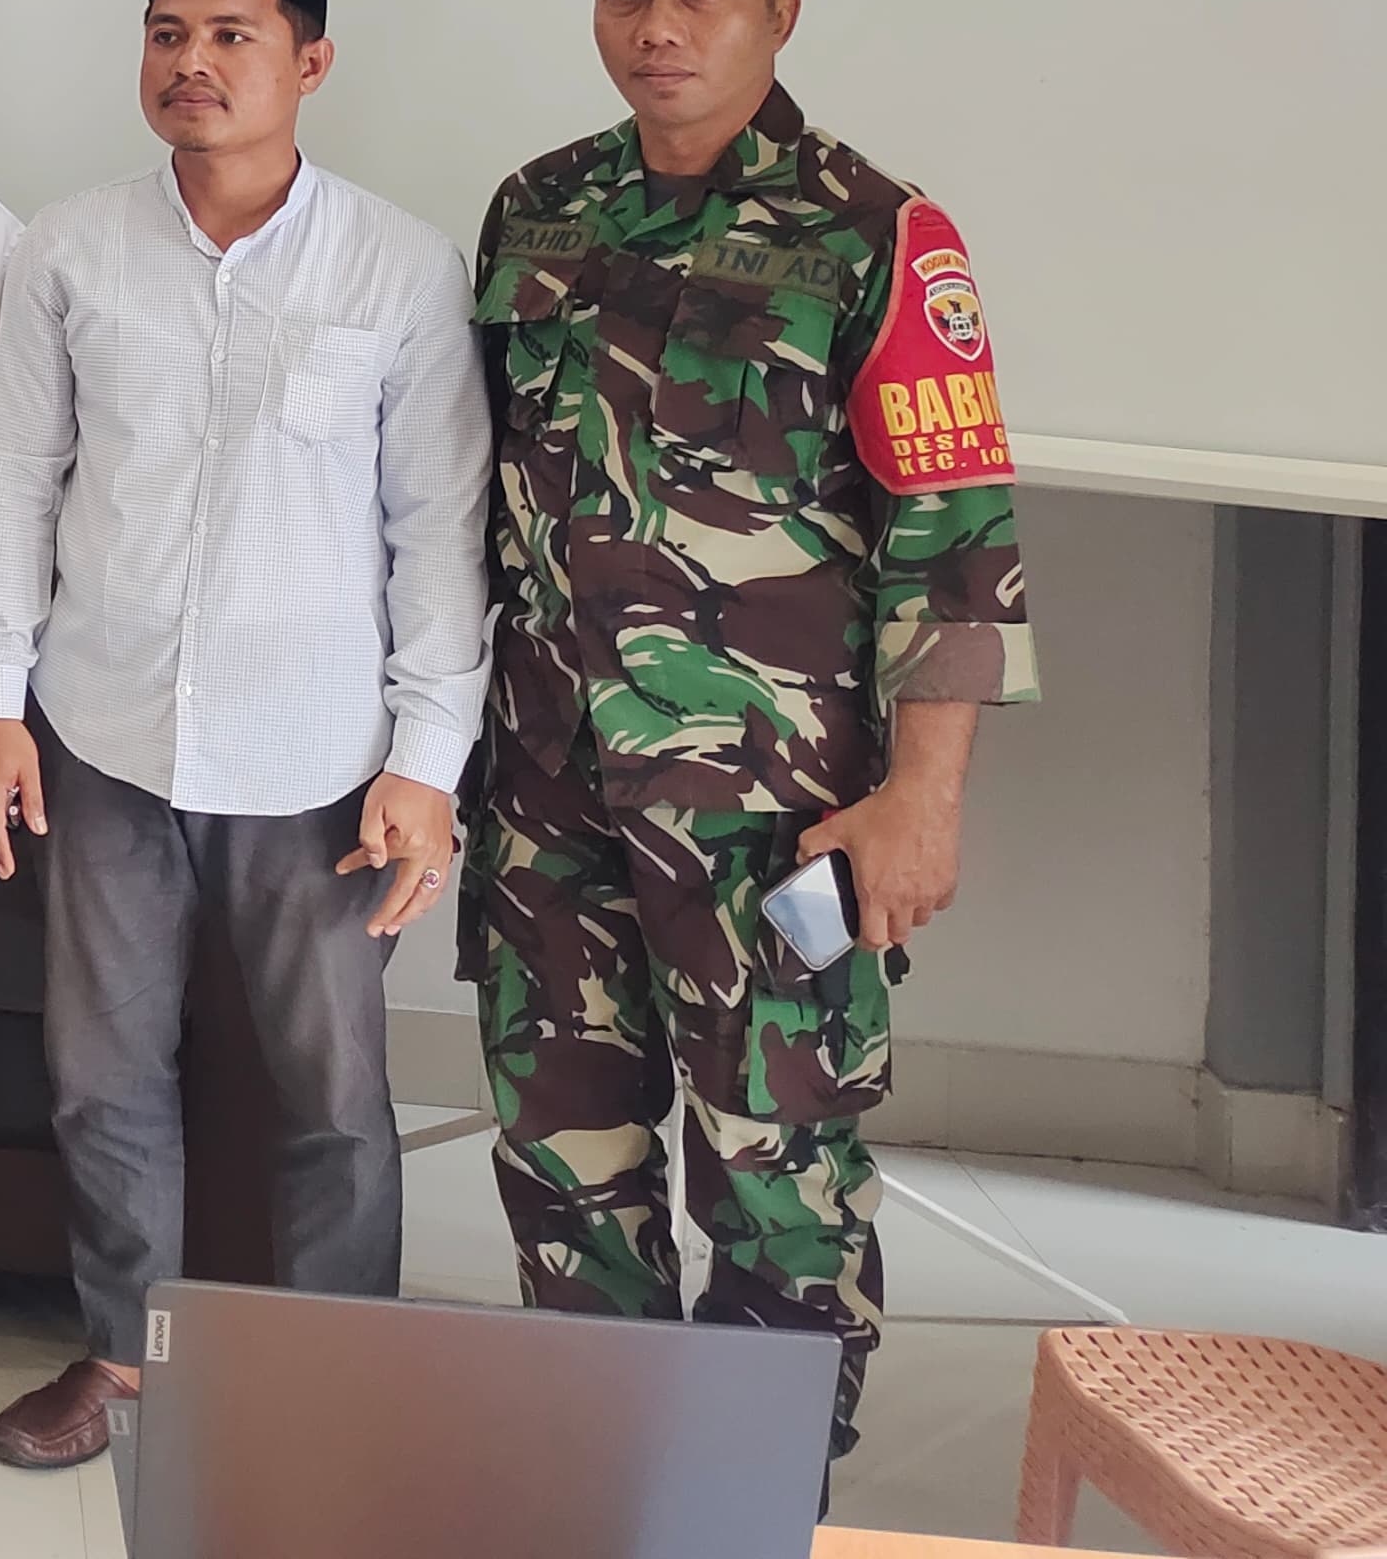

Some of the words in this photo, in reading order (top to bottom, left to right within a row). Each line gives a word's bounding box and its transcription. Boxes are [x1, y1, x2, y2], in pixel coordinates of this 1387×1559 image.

[715, 245, 770, 275] TNI
[783, 259, 835, 286] AD
[891, 430, 979, 456] DESA
[897, 453, 967, 476] KEC.
[151, 1314, 165, 1357] Lenovo
